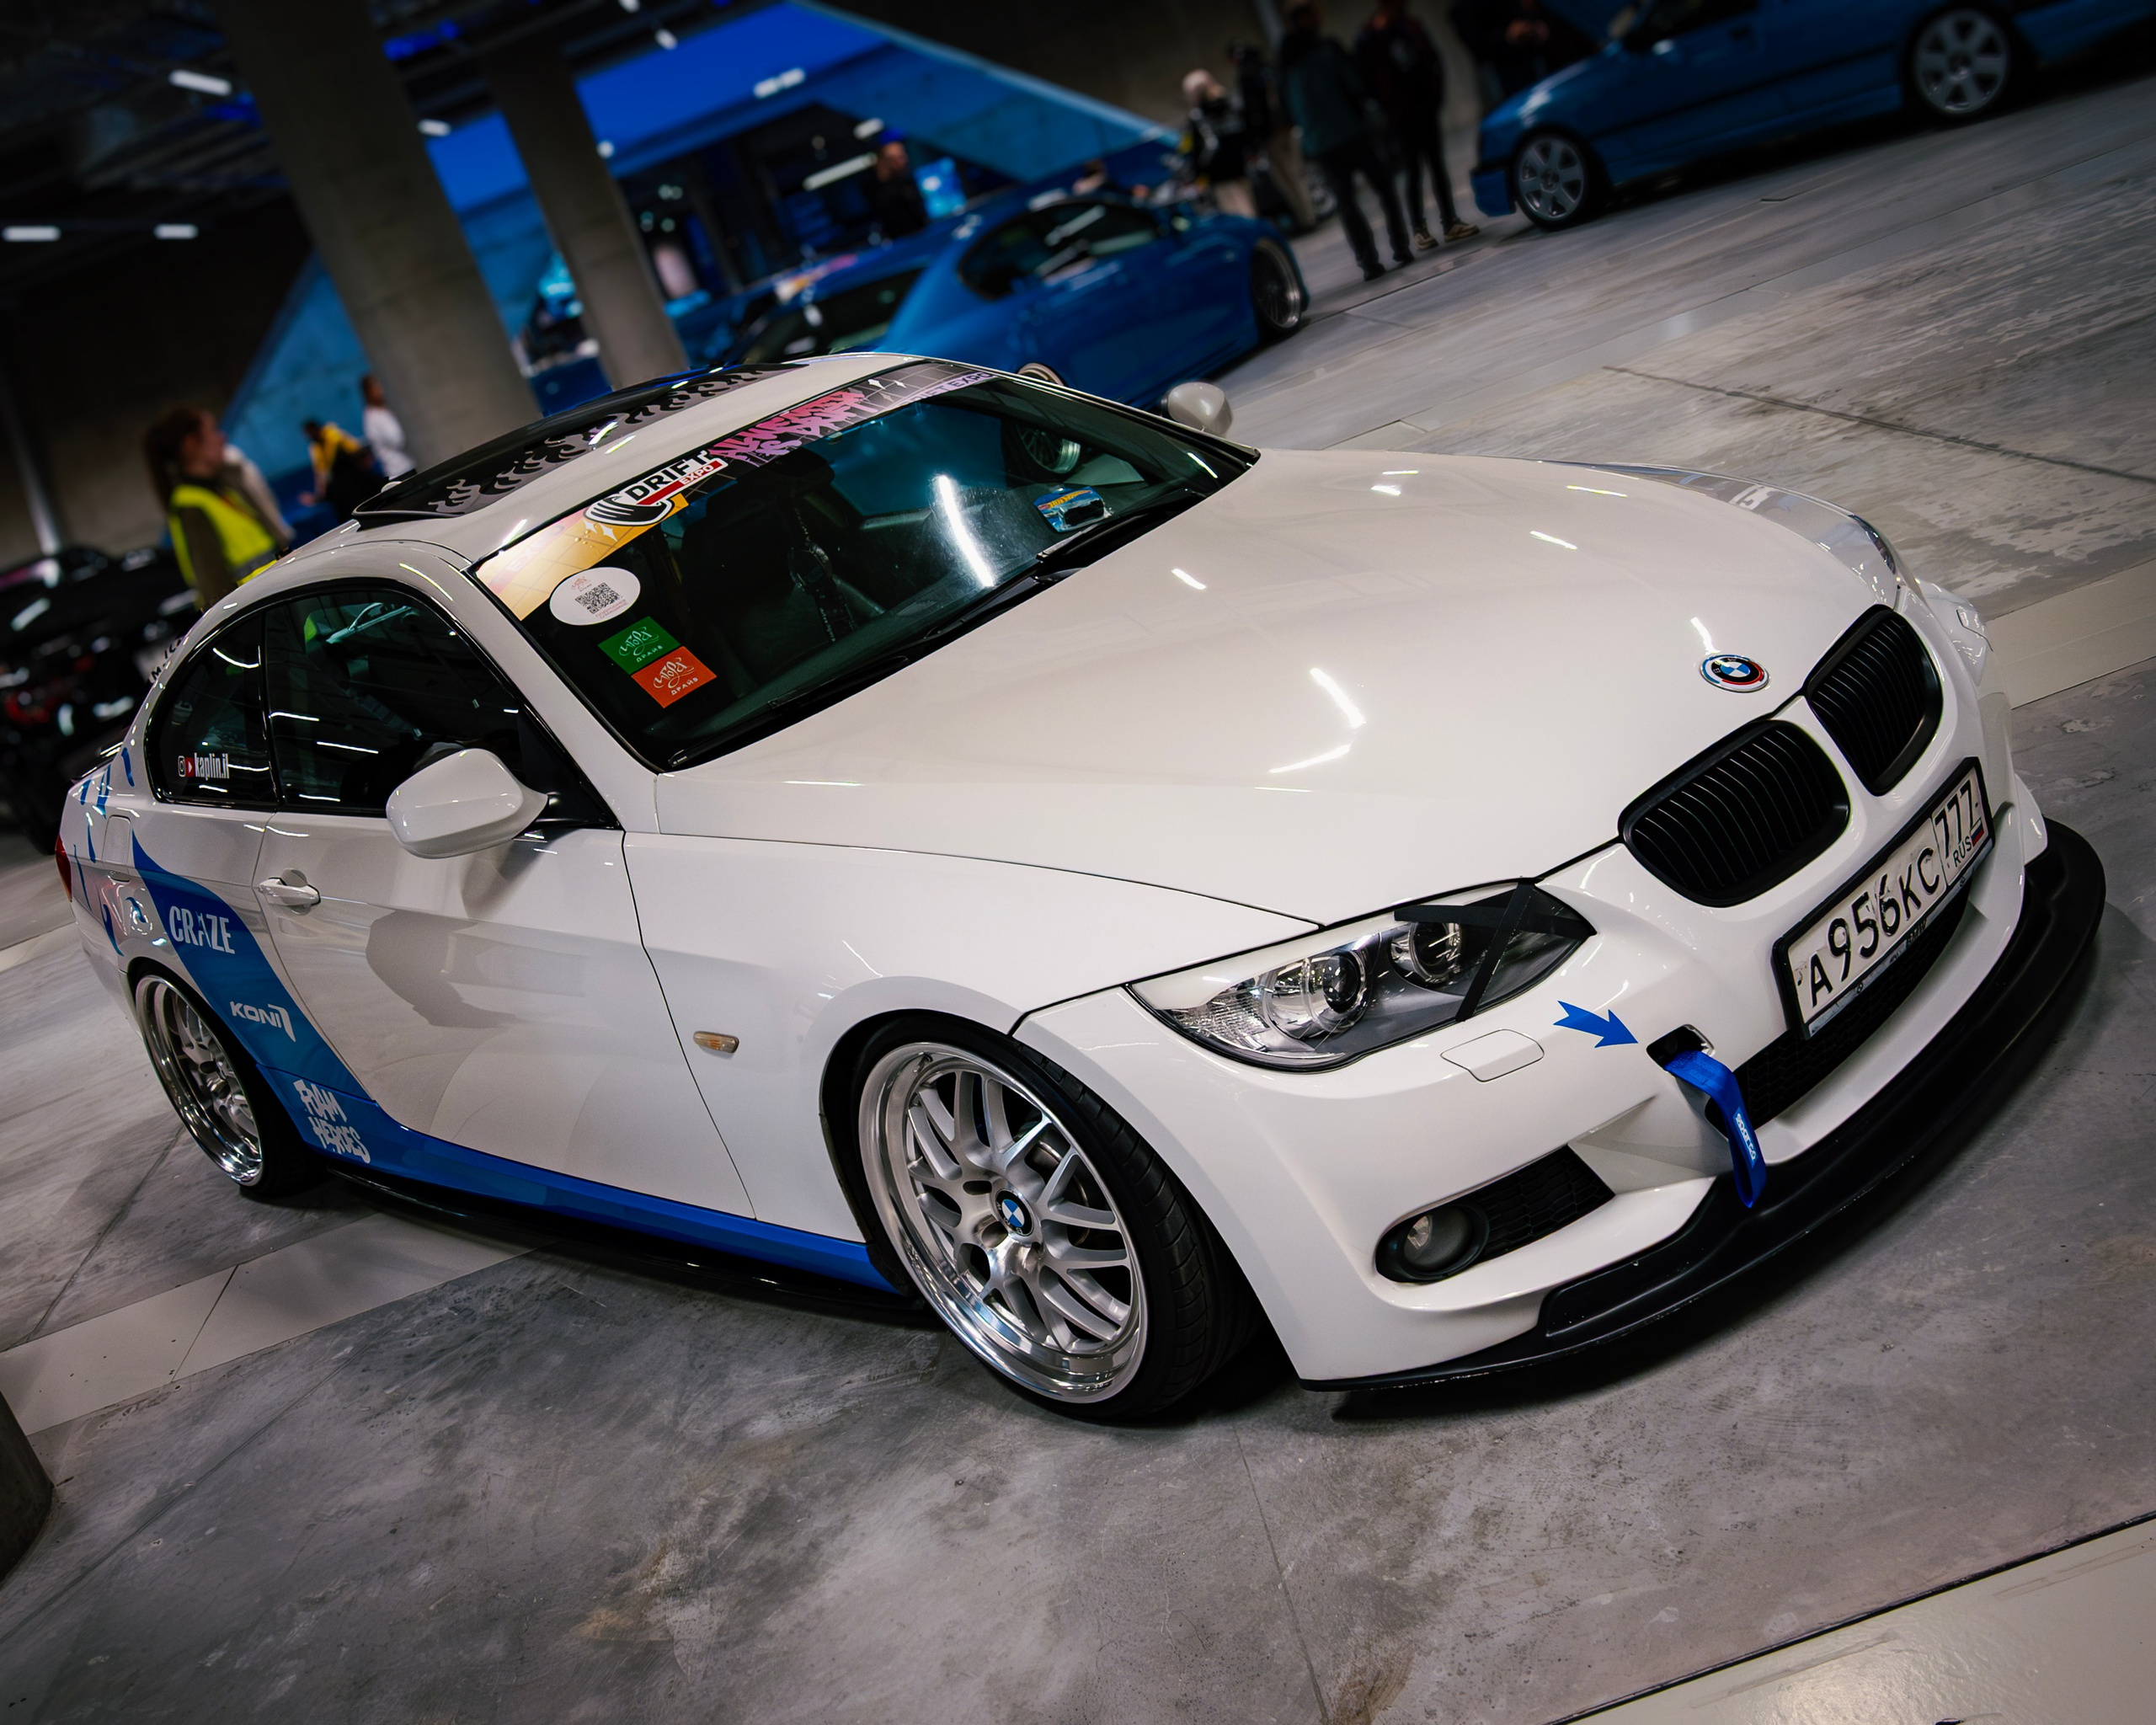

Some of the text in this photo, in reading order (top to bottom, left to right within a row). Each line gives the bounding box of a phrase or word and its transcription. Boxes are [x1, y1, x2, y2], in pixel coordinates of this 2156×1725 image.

[625, 449, 714, 501] DRIFT
[678, 464, 715, 486] EXPO
[670, 676, 699, 696] ДРАЙВ
[1934, 778, 1977, 859] 777
[1953, 835, 1972, 868] RUS
[169, 905, 236, 954] CRAZE
[230, 1001, 283, 1028] KONI
